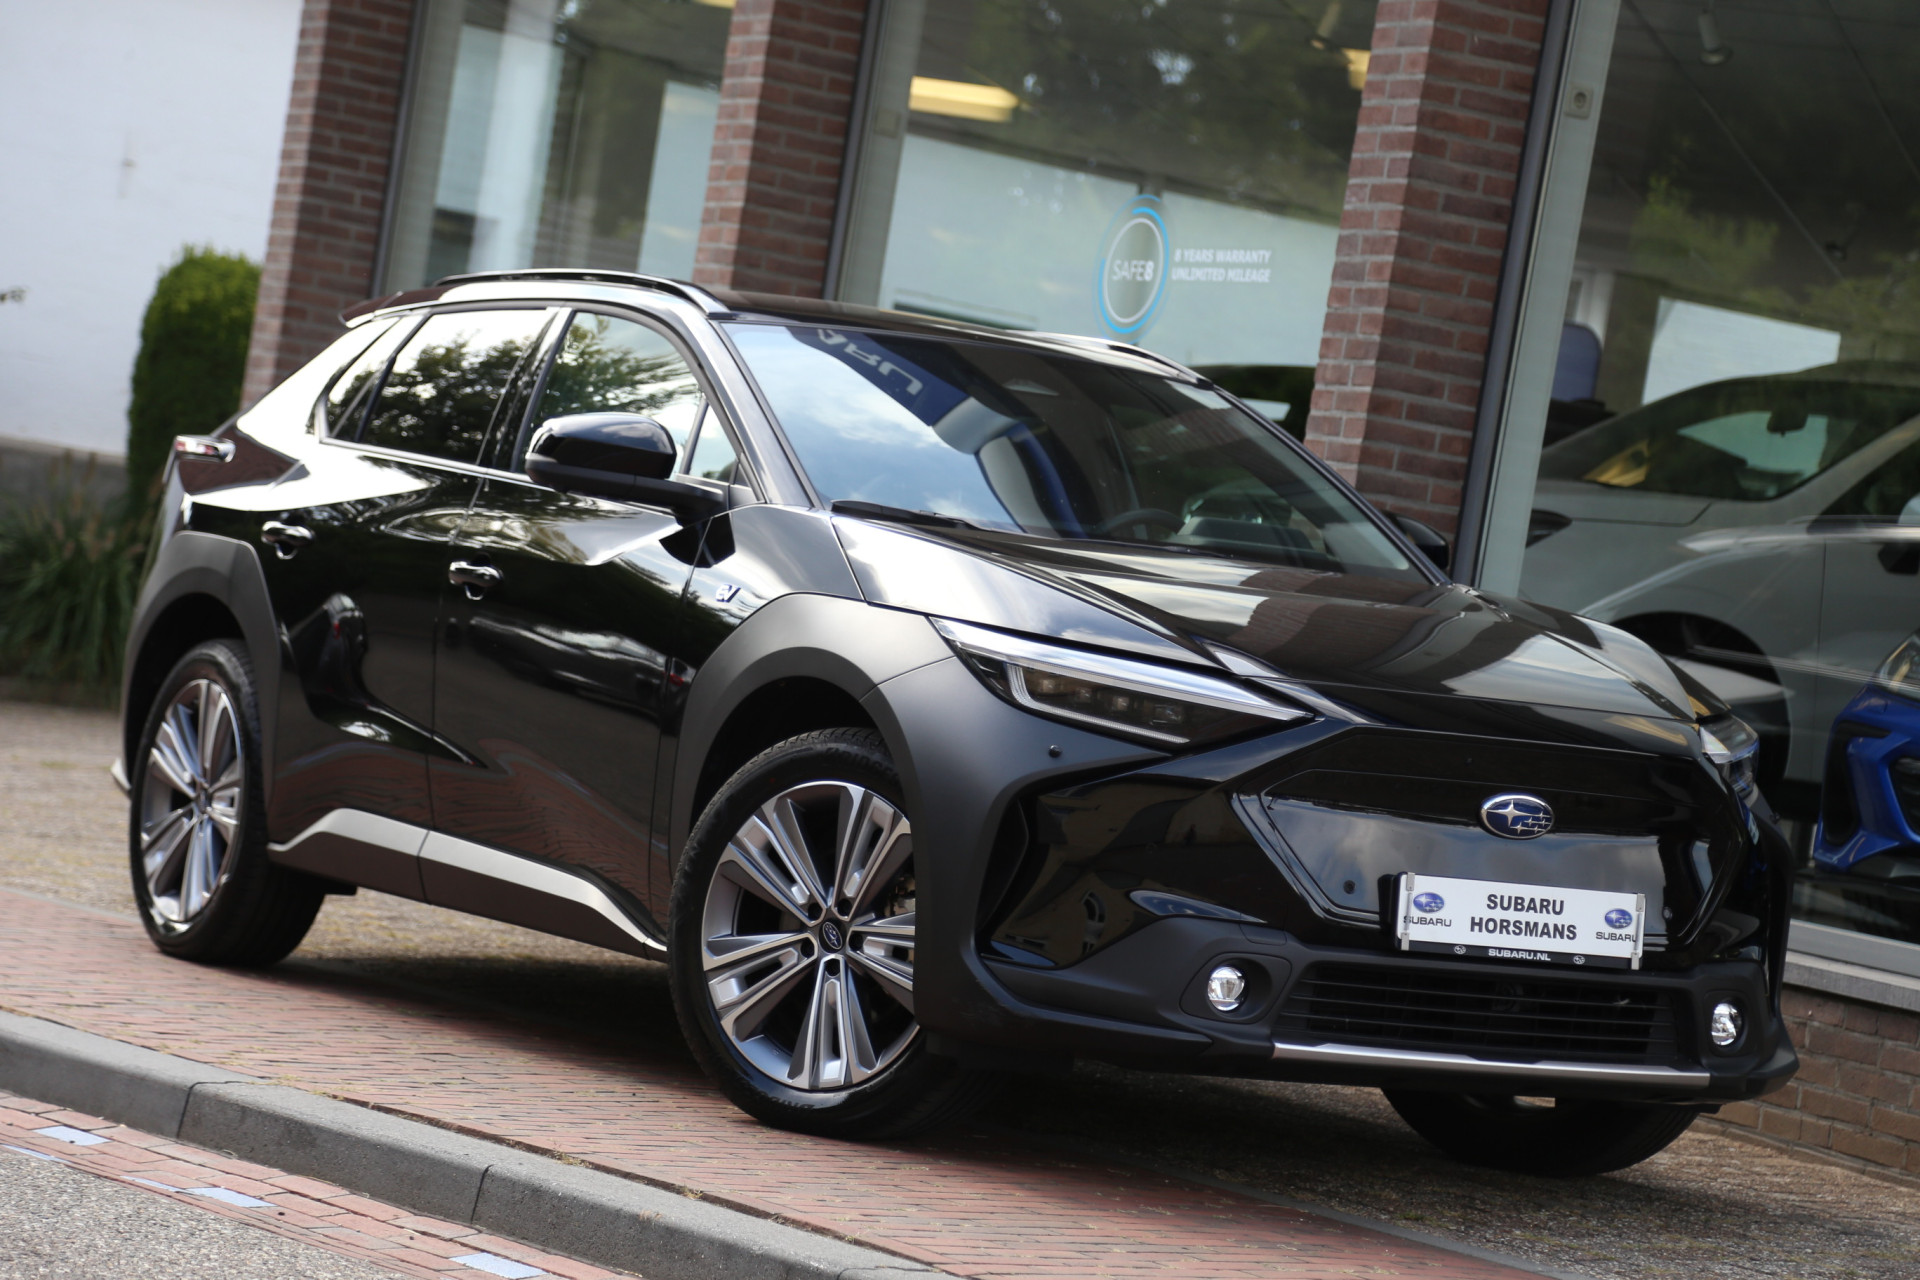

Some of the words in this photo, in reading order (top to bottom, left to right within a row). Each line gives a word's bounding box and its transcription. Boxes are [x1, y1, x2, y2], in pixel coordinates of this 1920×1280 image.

[1183, 248, 1215, 263] YEARS
[1216, 249, 1272, 264] WARRANTY
[1112, 260, 1155, 282] SAFE8
[1172, 267, 1225, 281] UNLIMITED
[1226, 268, 1271, 283] MILEAGE
[1486, 893, 1565, 916] SUBARU
[1403, 915, 1453, 928] SUBARU
[1470, 916, 1577, 941] HORSMANS
[1488, 948, 1551, 962] SUBARU.NL
